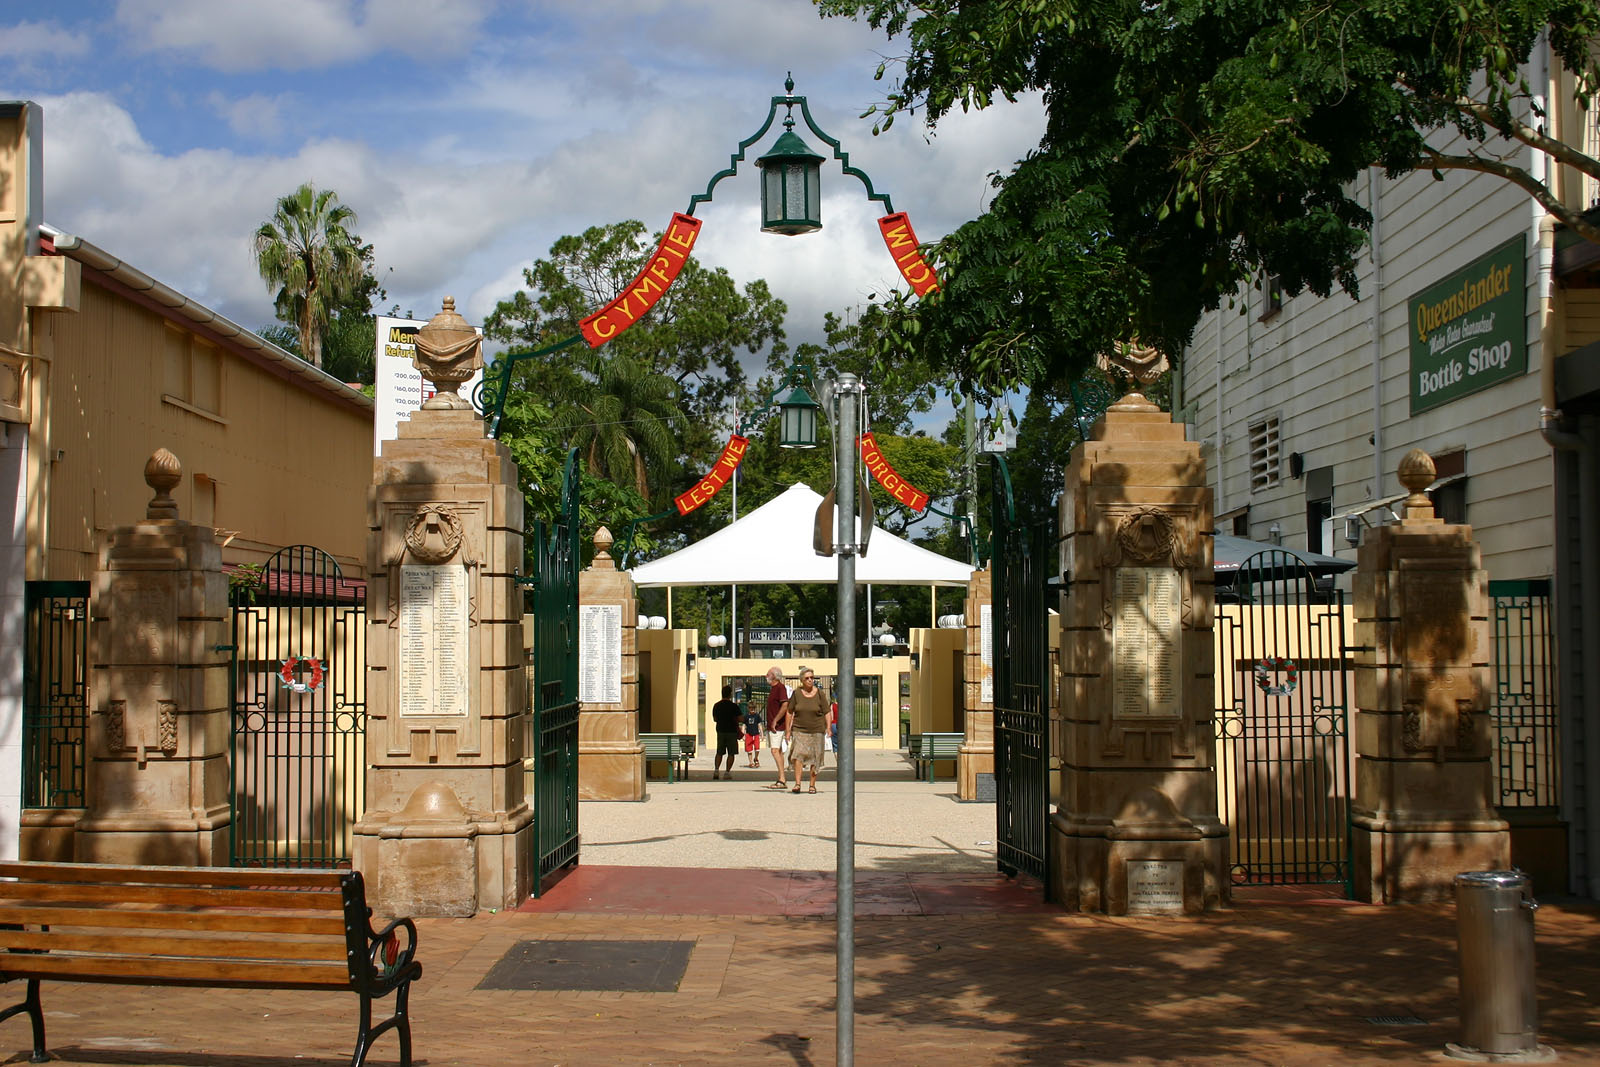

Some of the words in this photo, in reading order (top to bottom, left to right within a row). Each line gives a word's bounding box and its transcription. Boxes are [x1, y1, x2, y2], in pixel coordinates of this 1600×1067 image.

[1417, 263, 1513, 342] Queenslander
[1419, 358, 1463, 397] Bottle
[1467, 340, 1512, 376] Shop
[680, 469, 724, 512] LEST
[721, 440, 745, 468] WE
[861, 439, 922, 507] FORGET
